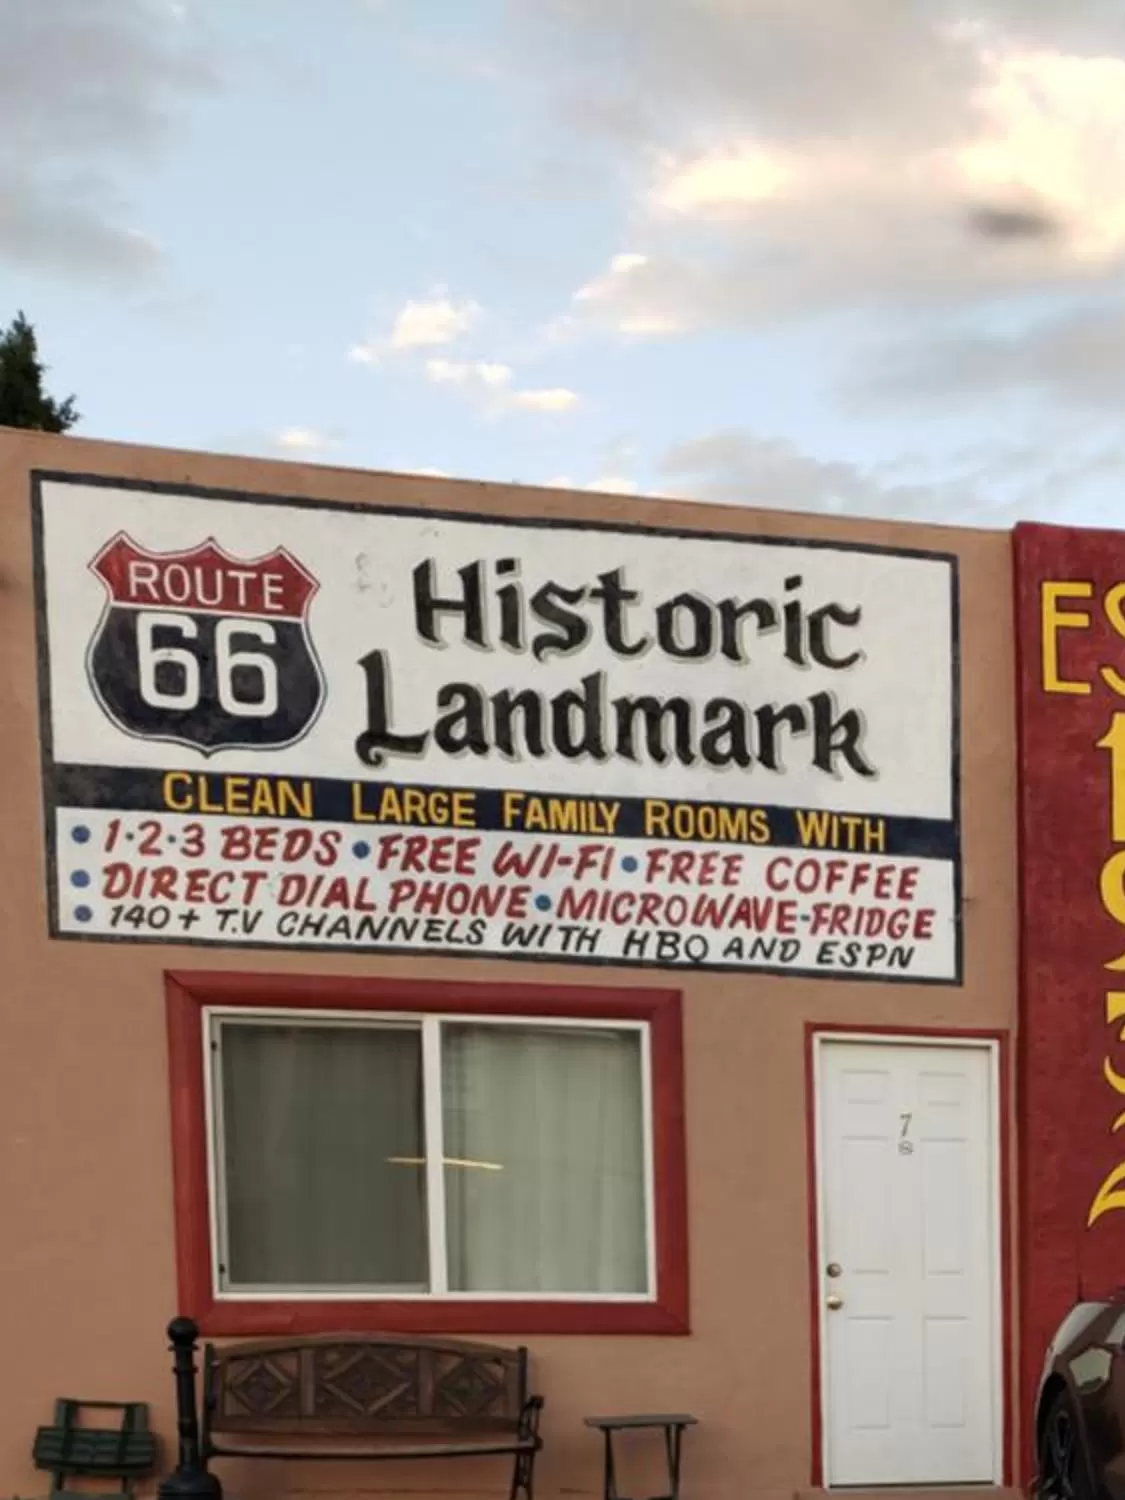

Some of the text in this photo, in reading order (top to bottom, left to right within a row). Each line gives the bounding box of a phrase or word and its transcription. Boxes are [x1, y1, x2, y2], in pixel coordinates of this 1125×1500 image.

[128, 560, 285, 611] ROUTE
[413, 558, 864, 670] Historic
[136, 611, 280, 718] 66
[355, 649, 877, 780] Landmark
[162, 771, 886, 852] CLEAN LARGE FAMILY ROOMS WITH
[102, 861, 268, 905] DIRECT
[277, 873, 377, 911] DIAL
[387, 878, 532, 919] PHONE
[220, 824, 342, 867] BEDS
[377, 832, 482, 876] FREE
[492, 840, 616, 881] WI-FI
[645, 847, 744, 887] FREE
[765, 855, 920, 901] COFFEE
[110, 904, 200, 931] 140+
[276, 911, 487, 946] CHANNELS
[501, 922, 602, 954] WITH
[622, 928, 709, 962] HBO
[722, 936, 801, 963] AND
[816, 940, 915, 969] ESPN
[899, 1112, 913, 1137] 7
